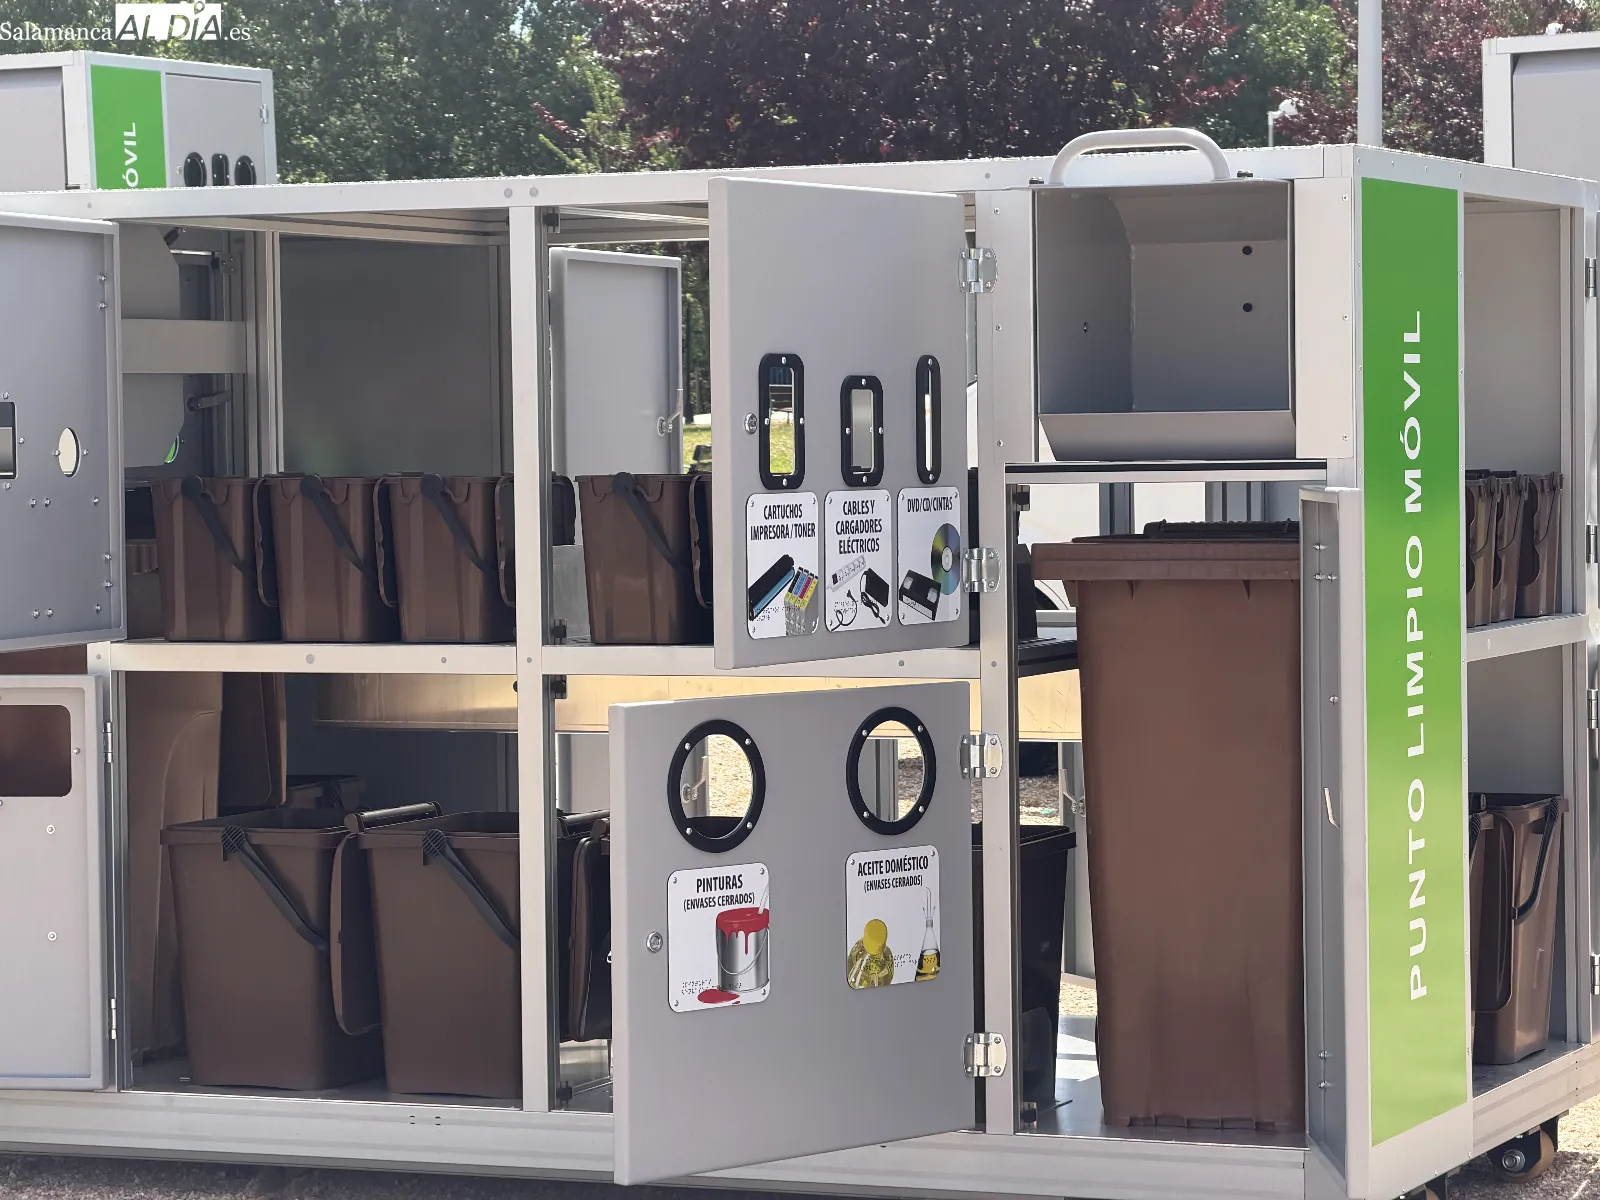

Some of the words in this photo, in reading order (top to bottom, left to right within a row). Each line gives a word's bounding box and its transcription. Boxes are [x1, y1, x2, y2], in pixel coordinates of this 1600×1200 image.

[121, 122, 139, 188] ÓVIL
[1399, 311, 1421, 513] MÓVIL
[763, 503, 803, 520] CARTUCHOS
[842, 499, 870, 516] CABLES
[870, 499, 876, 514] Y
[907, 496, 953, 513] DVD/CD/CINTAS
[835, 518, 883, 535] CARGADORES
[838, 537, 880, 555] ELÉCTRICOS
[1405, 535, 1424, 757] LIMPIO
[857, 860, 884, 877] ACEITE
[885, 855, 929, 873] DOMÉSTICO
[696, 874, 743, 893] PINTURAS
[863, 878, 891, 893] (ENVASES
[891, 874, 923, 889] CERRADOS)
[1408, 778, 1426, 1001] PUNTO
[683, 896, 716, 912] (ENVASES
[717, 891, 755, 908] CERRADOS)
